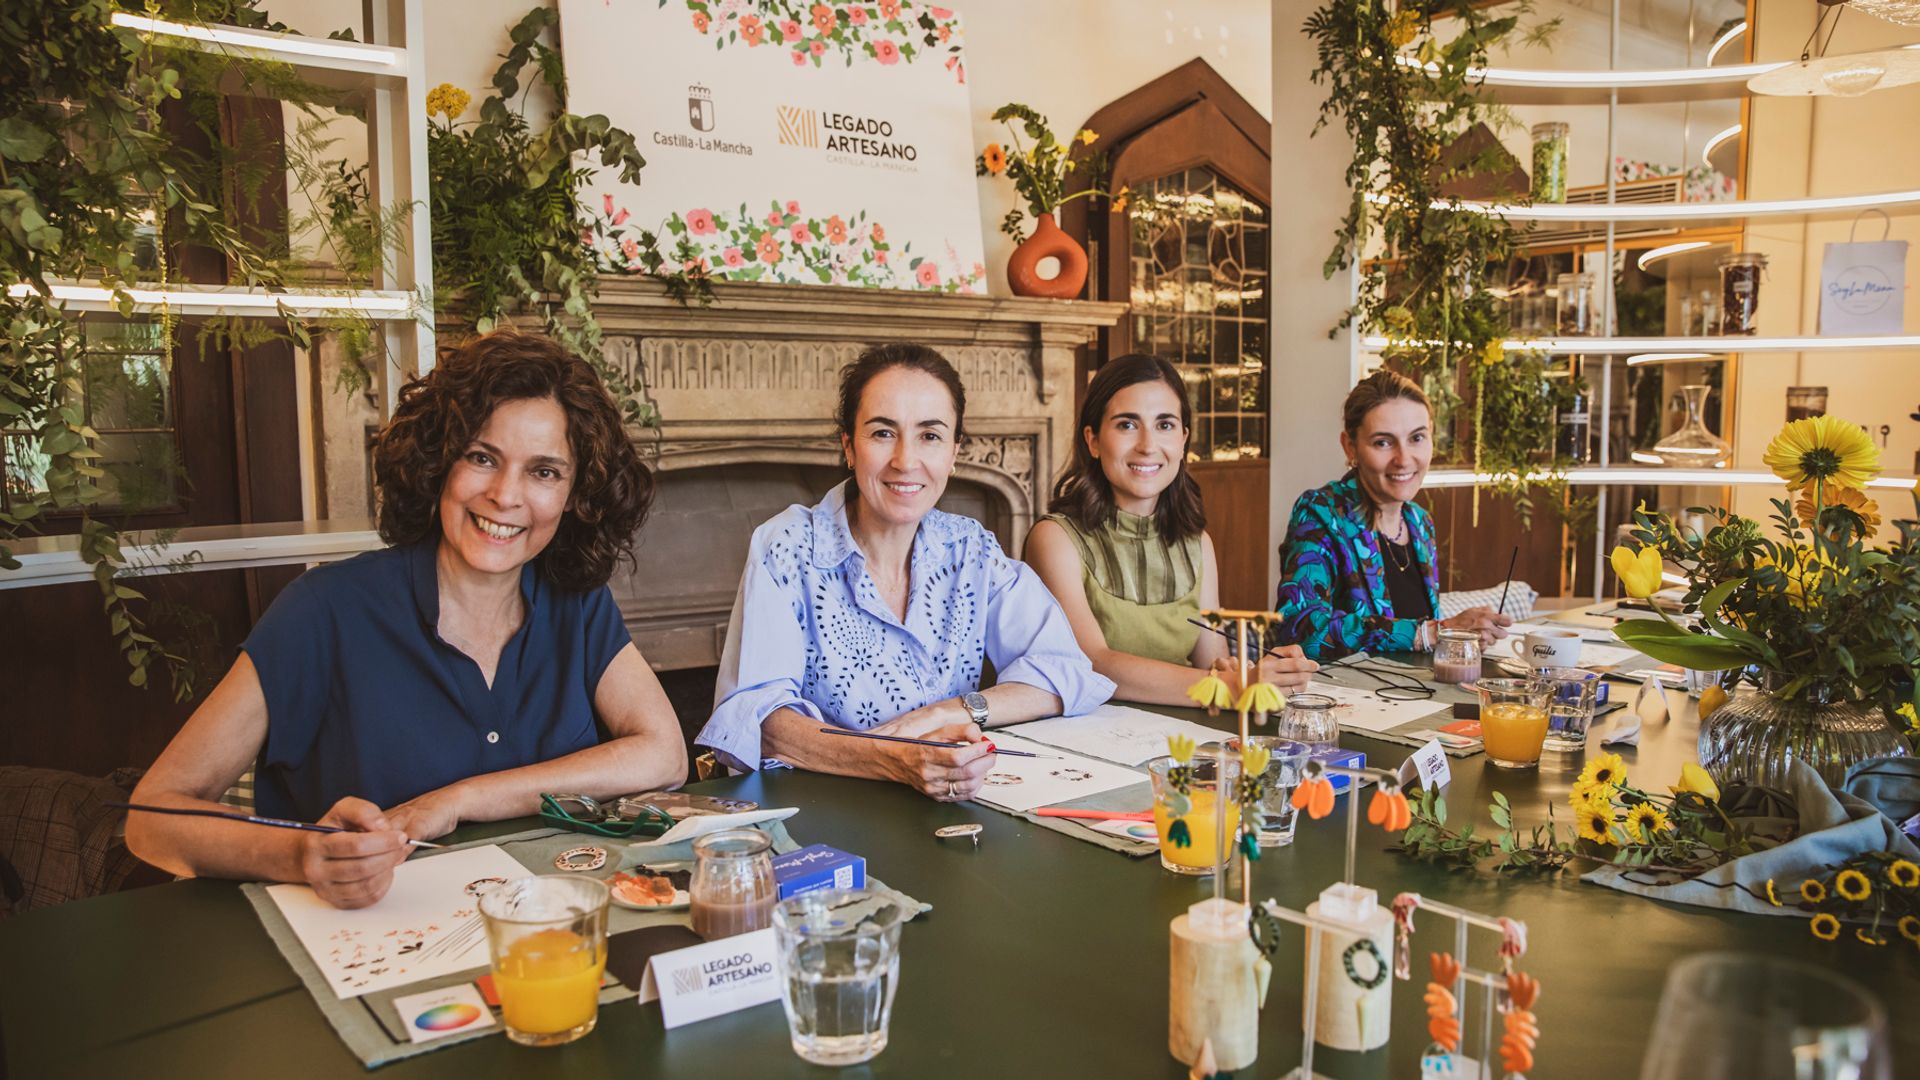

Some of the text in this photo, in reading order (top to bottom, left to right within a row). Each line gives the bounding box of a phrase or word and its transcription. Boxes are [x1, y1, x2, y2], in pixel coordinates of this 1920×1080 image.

[822, 111, 893, 137] LEGADO
[713, 139, 753, 156] Mancha
[826, 134, 917, 161] ARTESANO
[703, 952, 753, 974] LEGADO
[708, 961, 772, 987] ARTESANO
